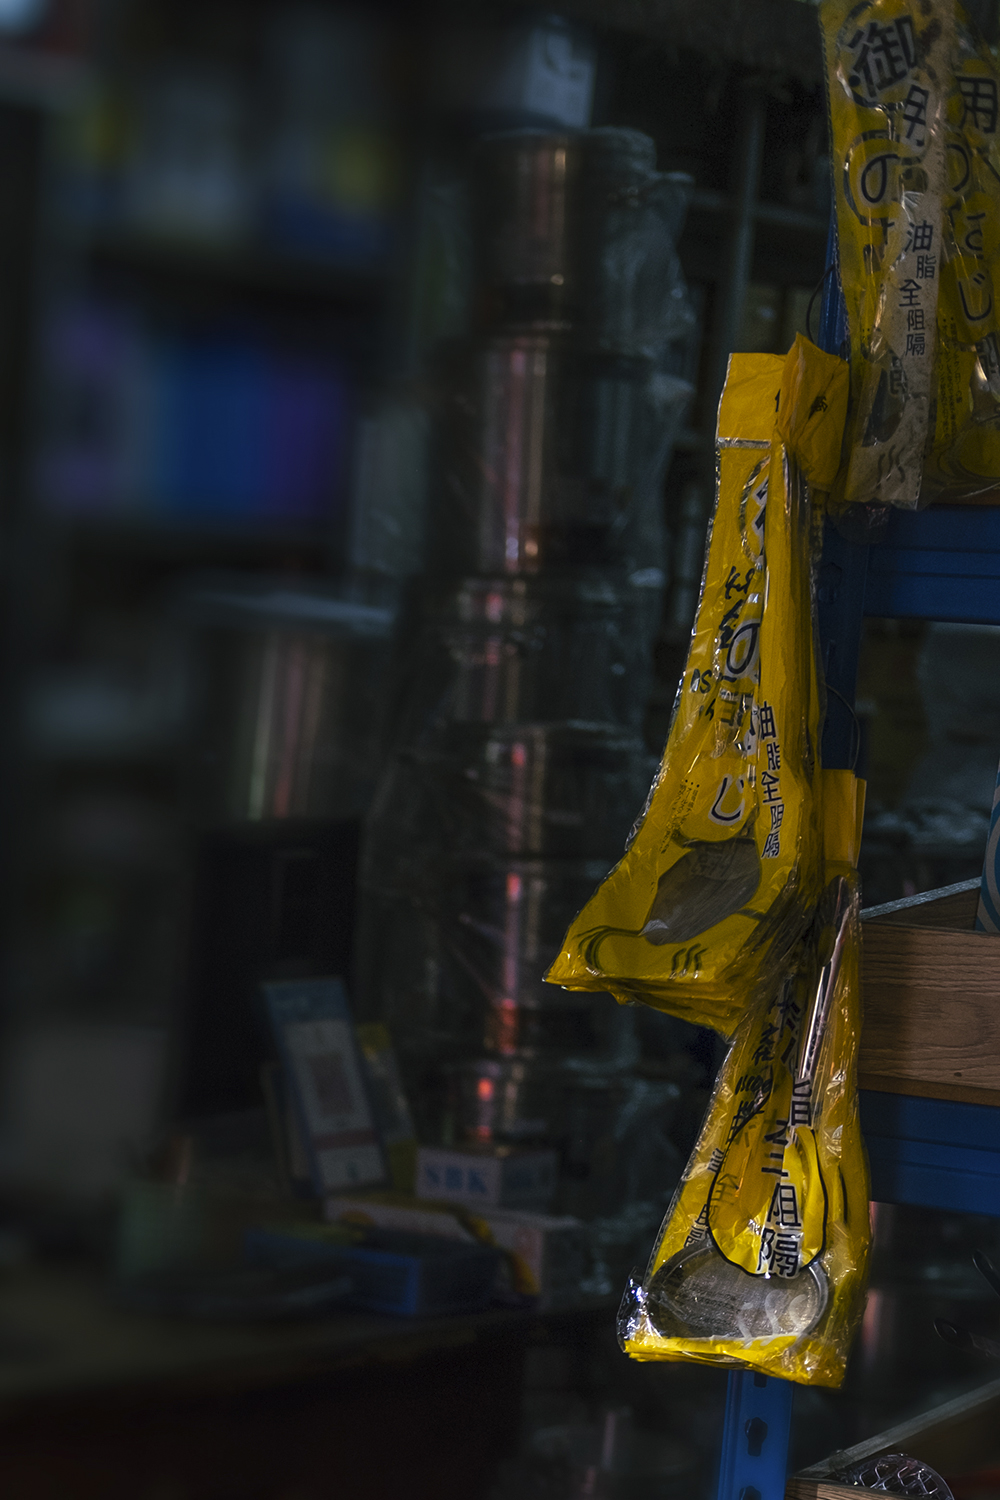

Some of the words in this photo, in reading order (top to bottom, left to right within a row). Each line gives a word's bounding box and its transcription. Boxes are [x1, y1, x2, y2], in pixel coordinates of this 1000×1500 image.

[898, 219, 937, 357] 油脂全阻隔
